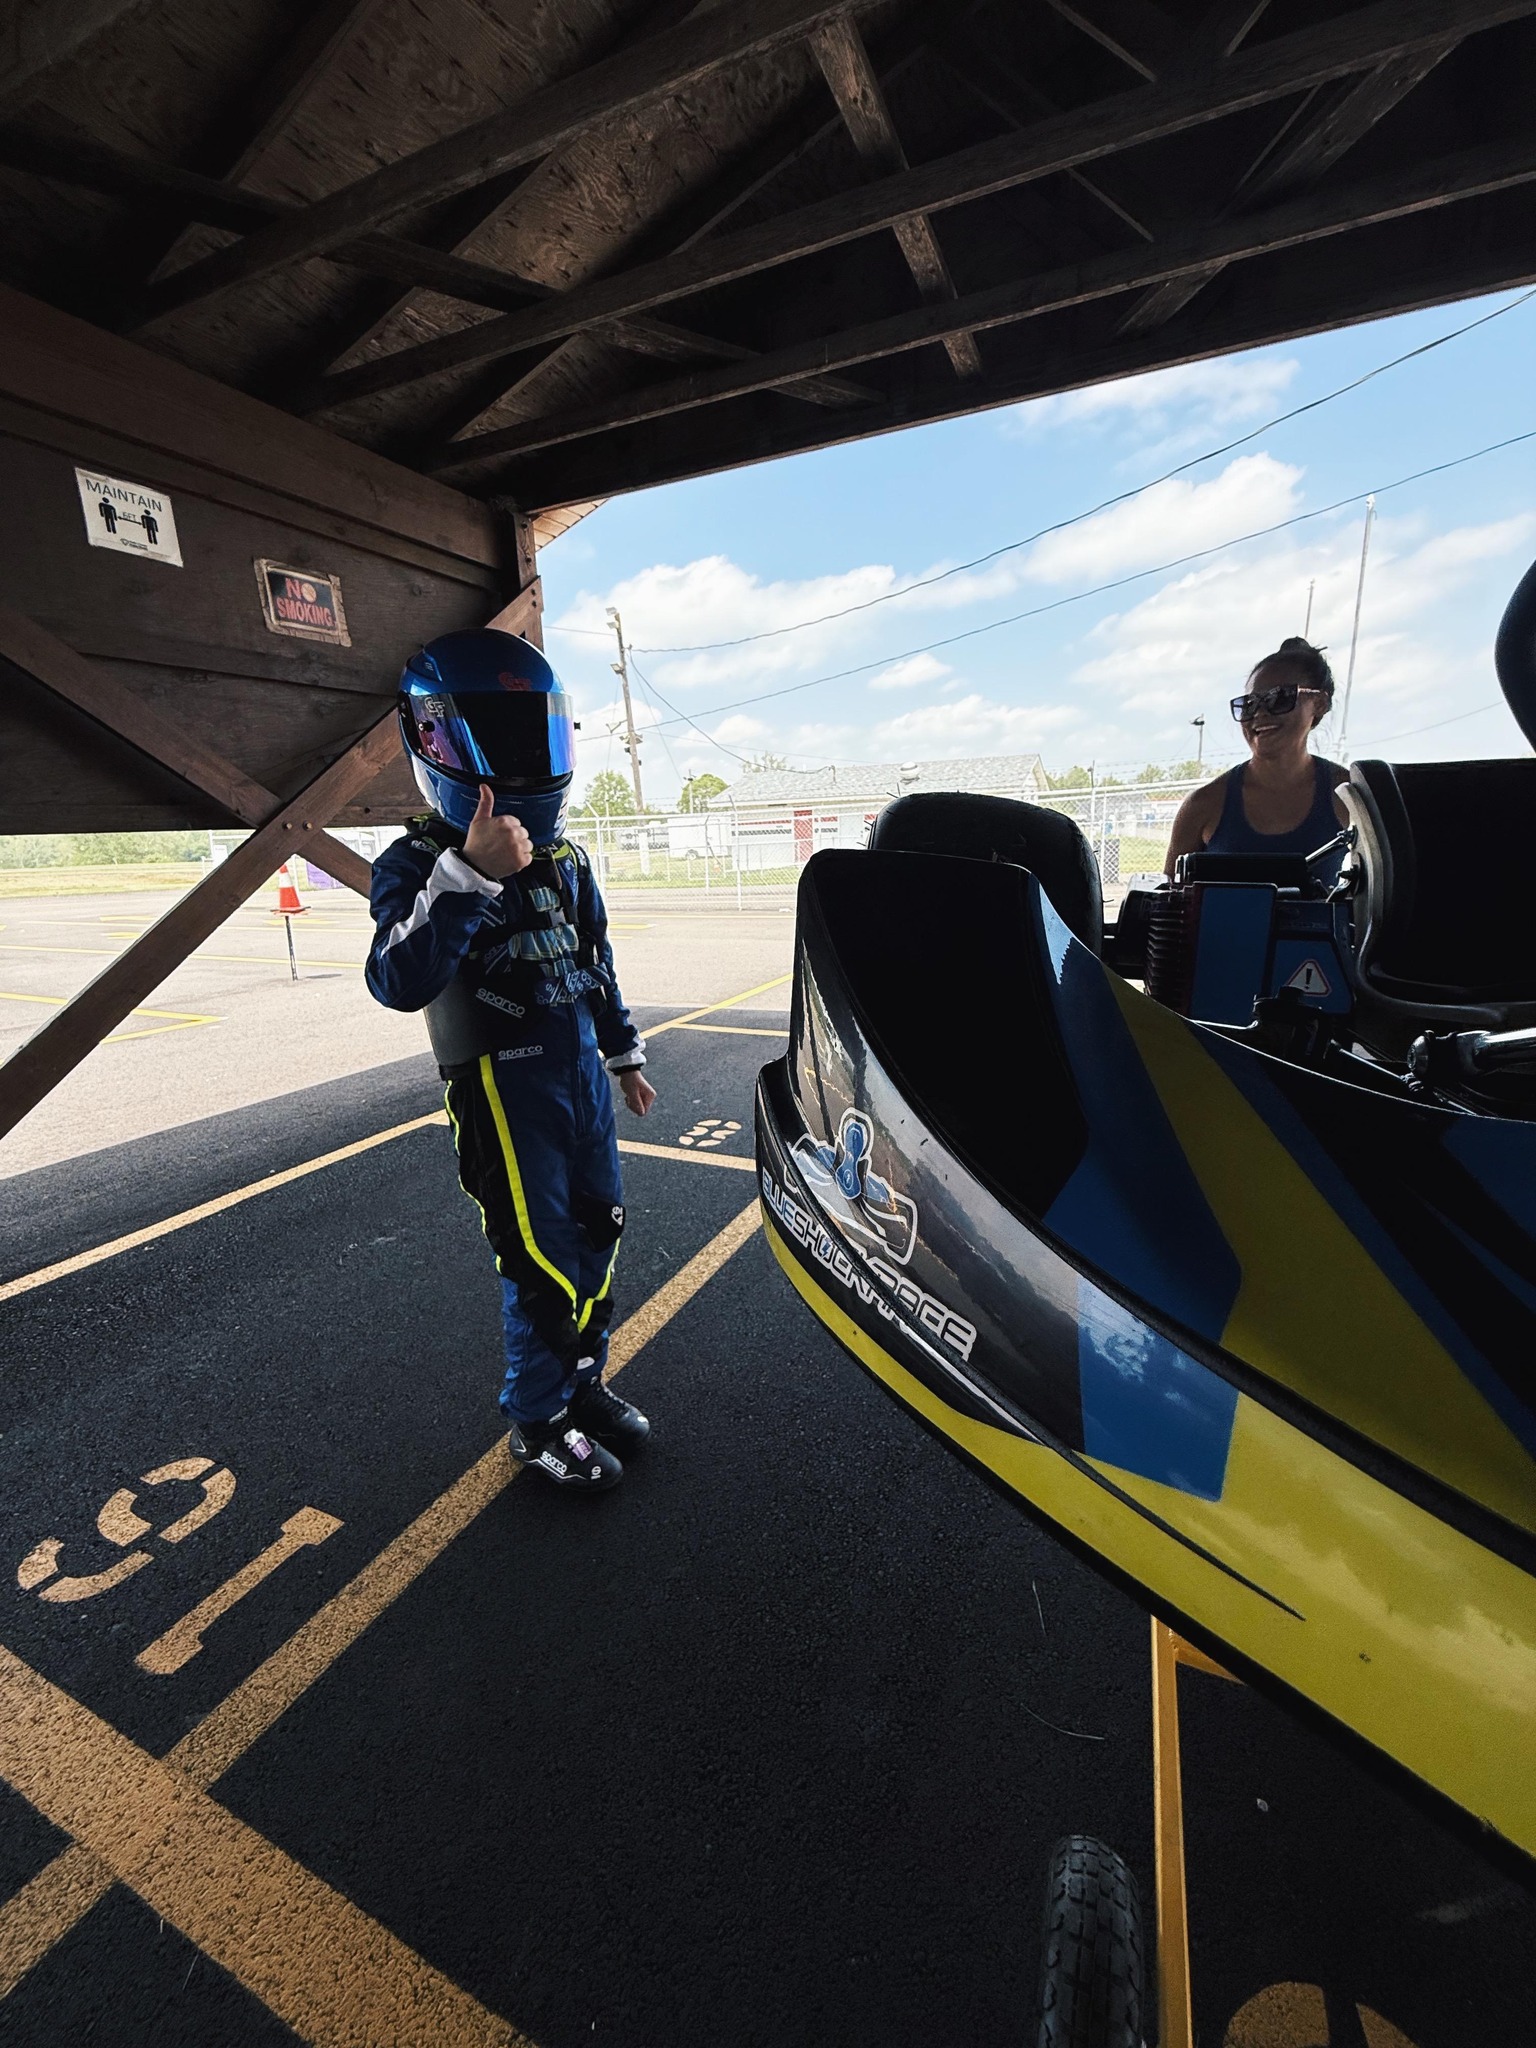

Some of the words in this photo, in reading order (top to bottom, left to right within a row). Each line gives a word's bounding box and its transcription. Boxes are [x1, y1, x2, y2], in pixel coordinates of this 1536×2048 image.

[86, 479, 162, 512] MAINTAIN
[285, 577, 317, 603] NO
[276, 596, 335, 627] SMOKING
[476, 987, 526, 1018] sparco
[498, 1044, 544, 1061] sparco
[540, 1450, 568, 1475] sparco
